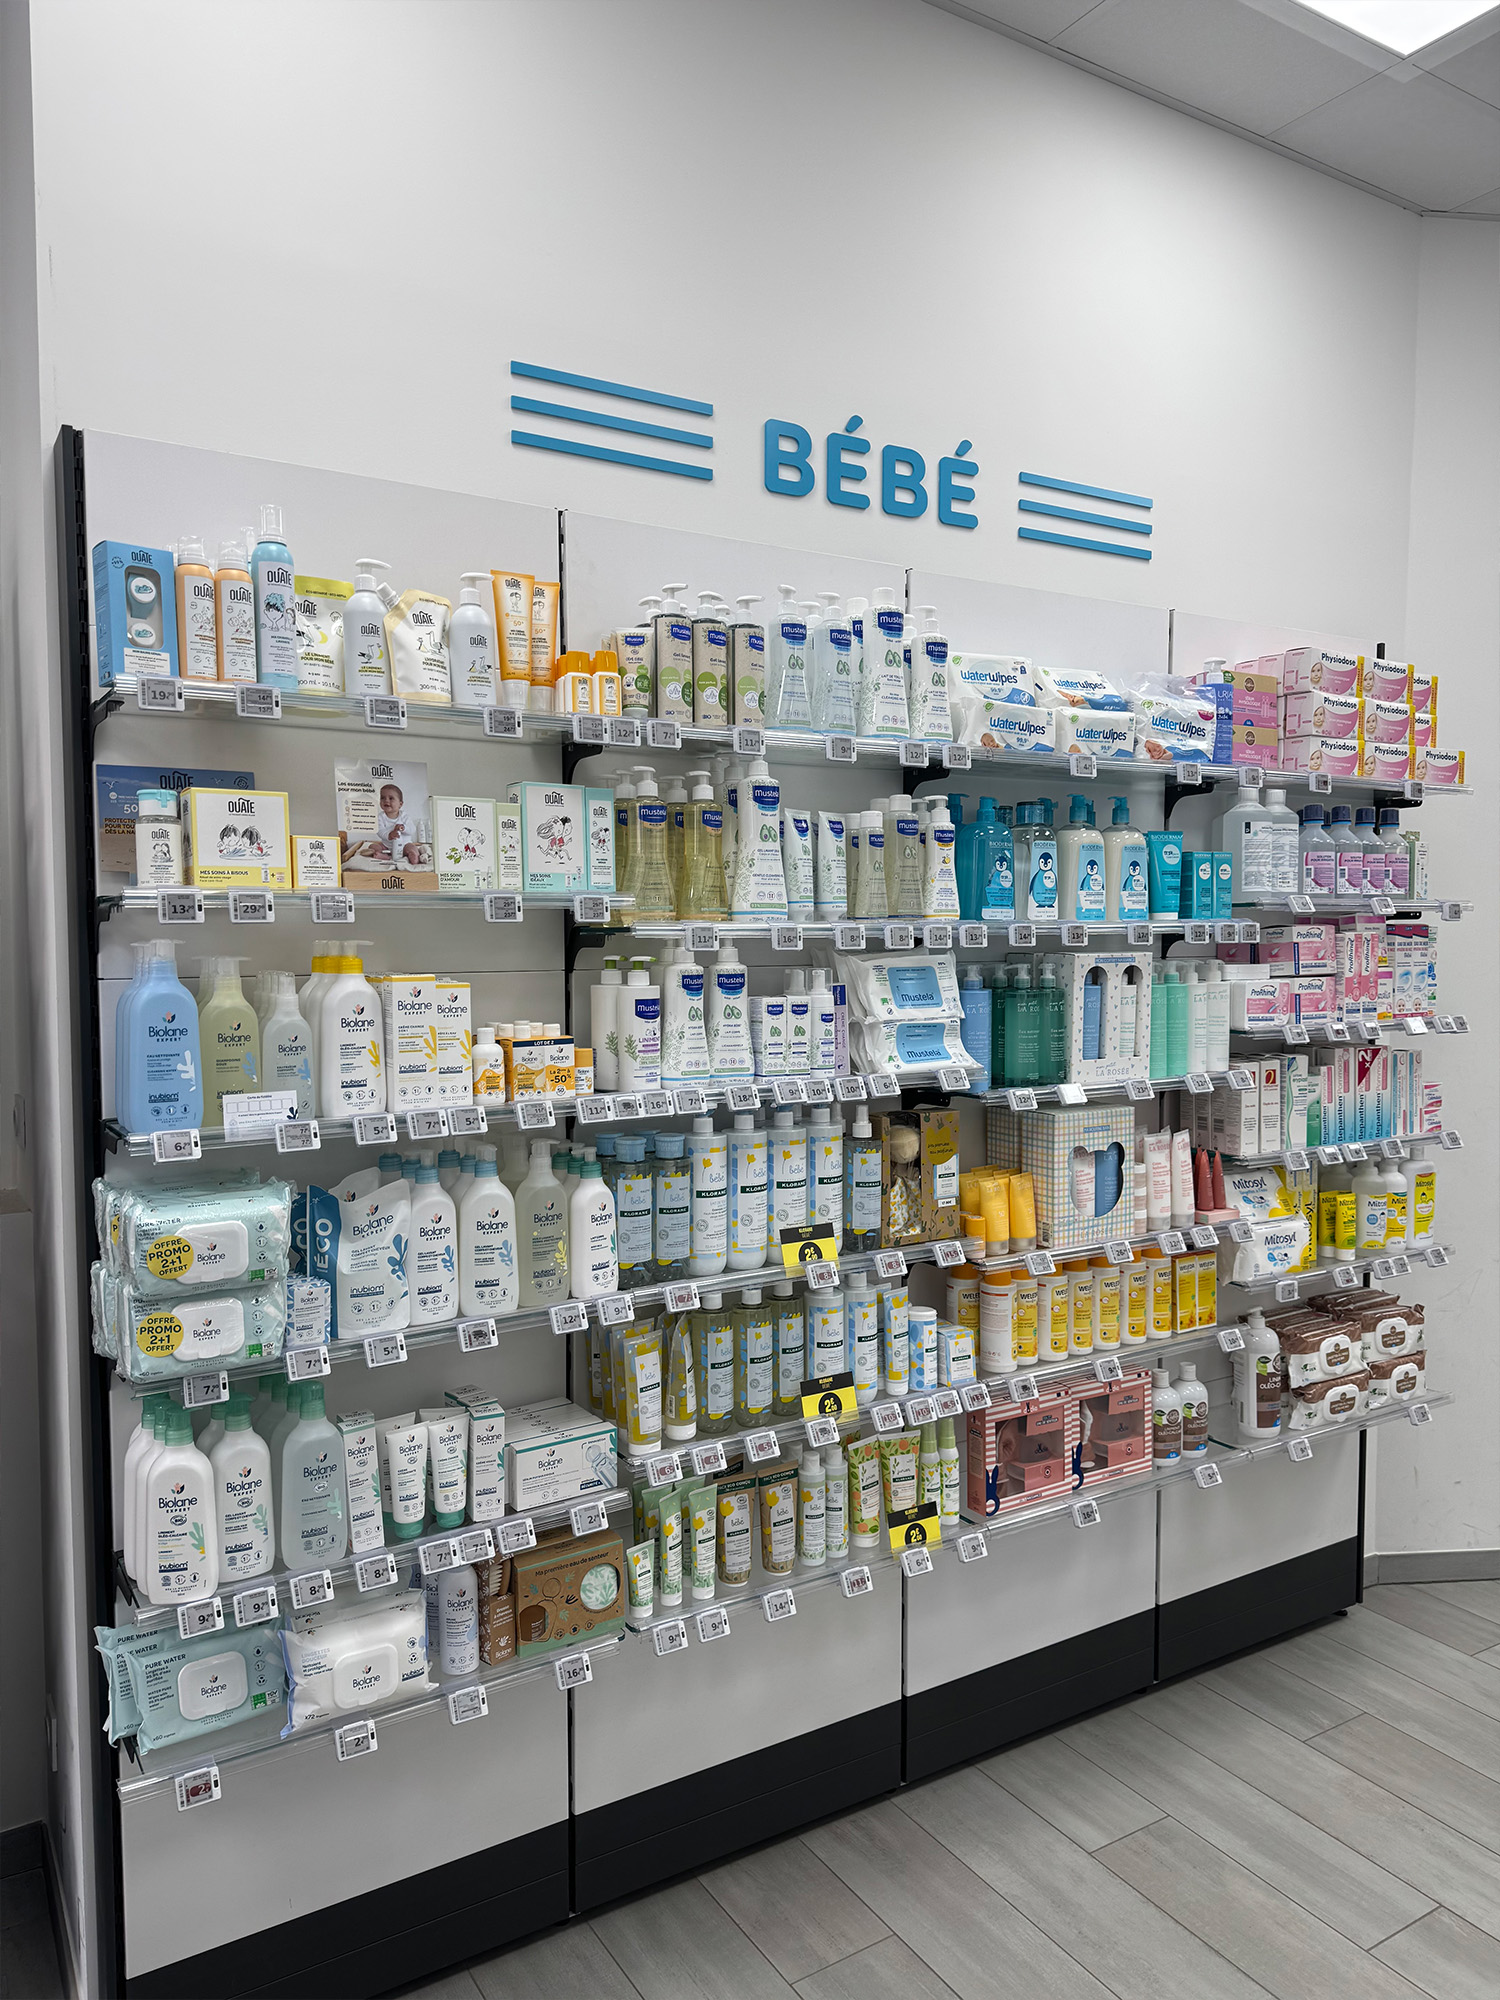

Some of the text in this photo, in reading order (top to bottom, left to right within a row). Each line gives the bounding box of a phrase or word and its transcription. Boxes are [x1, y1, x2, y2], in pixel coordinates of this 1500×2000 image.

[764, 415, 979, 529] BÉBÉ
[267, 567, 292, 586] OUATE
[413, 611, 434, 625] OUATE
[1321, 652, 1357, 667] Physiodose
[1373, 661, 1407, 675] Physiodose
[1323, 696, 1358, 709] Physiodose
[1375, 702, 1410, 716] Physiodose
[1320, 740, 1357, 753] Physiodose
[1374, 745, 1408, 758] Physiodose
[1425, 750, 1458, 763] Physiodose
[371, 763, 394, 778] OUATE
[544, 791, 564, 805] OUATE
[228, 798, 256, 814] OUATE
[454, 803, 476, 818] OUATE
[381, 875, 405, 890] OUATE
[901, 992, 936, 1003] Mustela
[397, 1000, 432, 1011] Biolane
[436, 1003, 468, 1014] Biolane
[340, 1017, 375, 1029] Biolane
[148, 1026, 189, 1038] Biolane
[217, 1032, 252, 1044] Biolane
[278, 1044, 307, 1053] Biolane
[907, 1049, 942, 1060] Mustela
[1232, 1177, 1267, 1191] Mitosyl
[533, 1211, 563, 1222] Biolane
[590, 1212, 613, 1221] Biolane
[352, 1215, 394, 1237] Biolane
[419, 1226, 451, 1237] Biolane
[476, 1220, 509, 1230] Biolane
[361, 1225, 387, 1239] EXPERT
[153, 1237, 183, 1250] OFFRE
[1264, 1234, 1297, 1247] Mitosyl
[148, 1245, 191, 1261] PROMO
[197, 1252, 226, 1263] Biolane
[160, 1256, 183, 1269] 2+1
[158, 1264, 188, 1276] OFFERT
[147, 1317, 175, 1325] OFFRE
[139, 1324, 182, 1336] PROMO
[193, 1327, 221, 1338] Biolane
[150, 1335, 172, 1345] 2+1
[145, 1344, 175, 1352] OFFERT
[439, 1433, 463, 1445] Biolane
[476, 1433, 502, 1444] Biolane
[347, 1444, 375, 1458] Biolane
[398, 1443, 424, 1455] Biolane
[537, 1457, 564, 1470] Biolane
[302, 1463, 337, 1479] Biolane
[309, 1474, 332, 1482] EXPERT
[225, 1478, 263, 1494] Biolane
[233, 1489, 256, 1497] EXPERT
[158, 1495, 198, 1510] Biolane
[544, 1563, 568, 1576] première
[447, 1597, 474, 1609] Biolane
[117, 1630, 158, 1643] PURE WATER
[135, 1643, 158, 1654] WATER
[144, 1654, 187, 1670] PURE WATER
[352, 1673, 381, 1690] Biolane
[200, 1683, 227, 1696] Biolane
